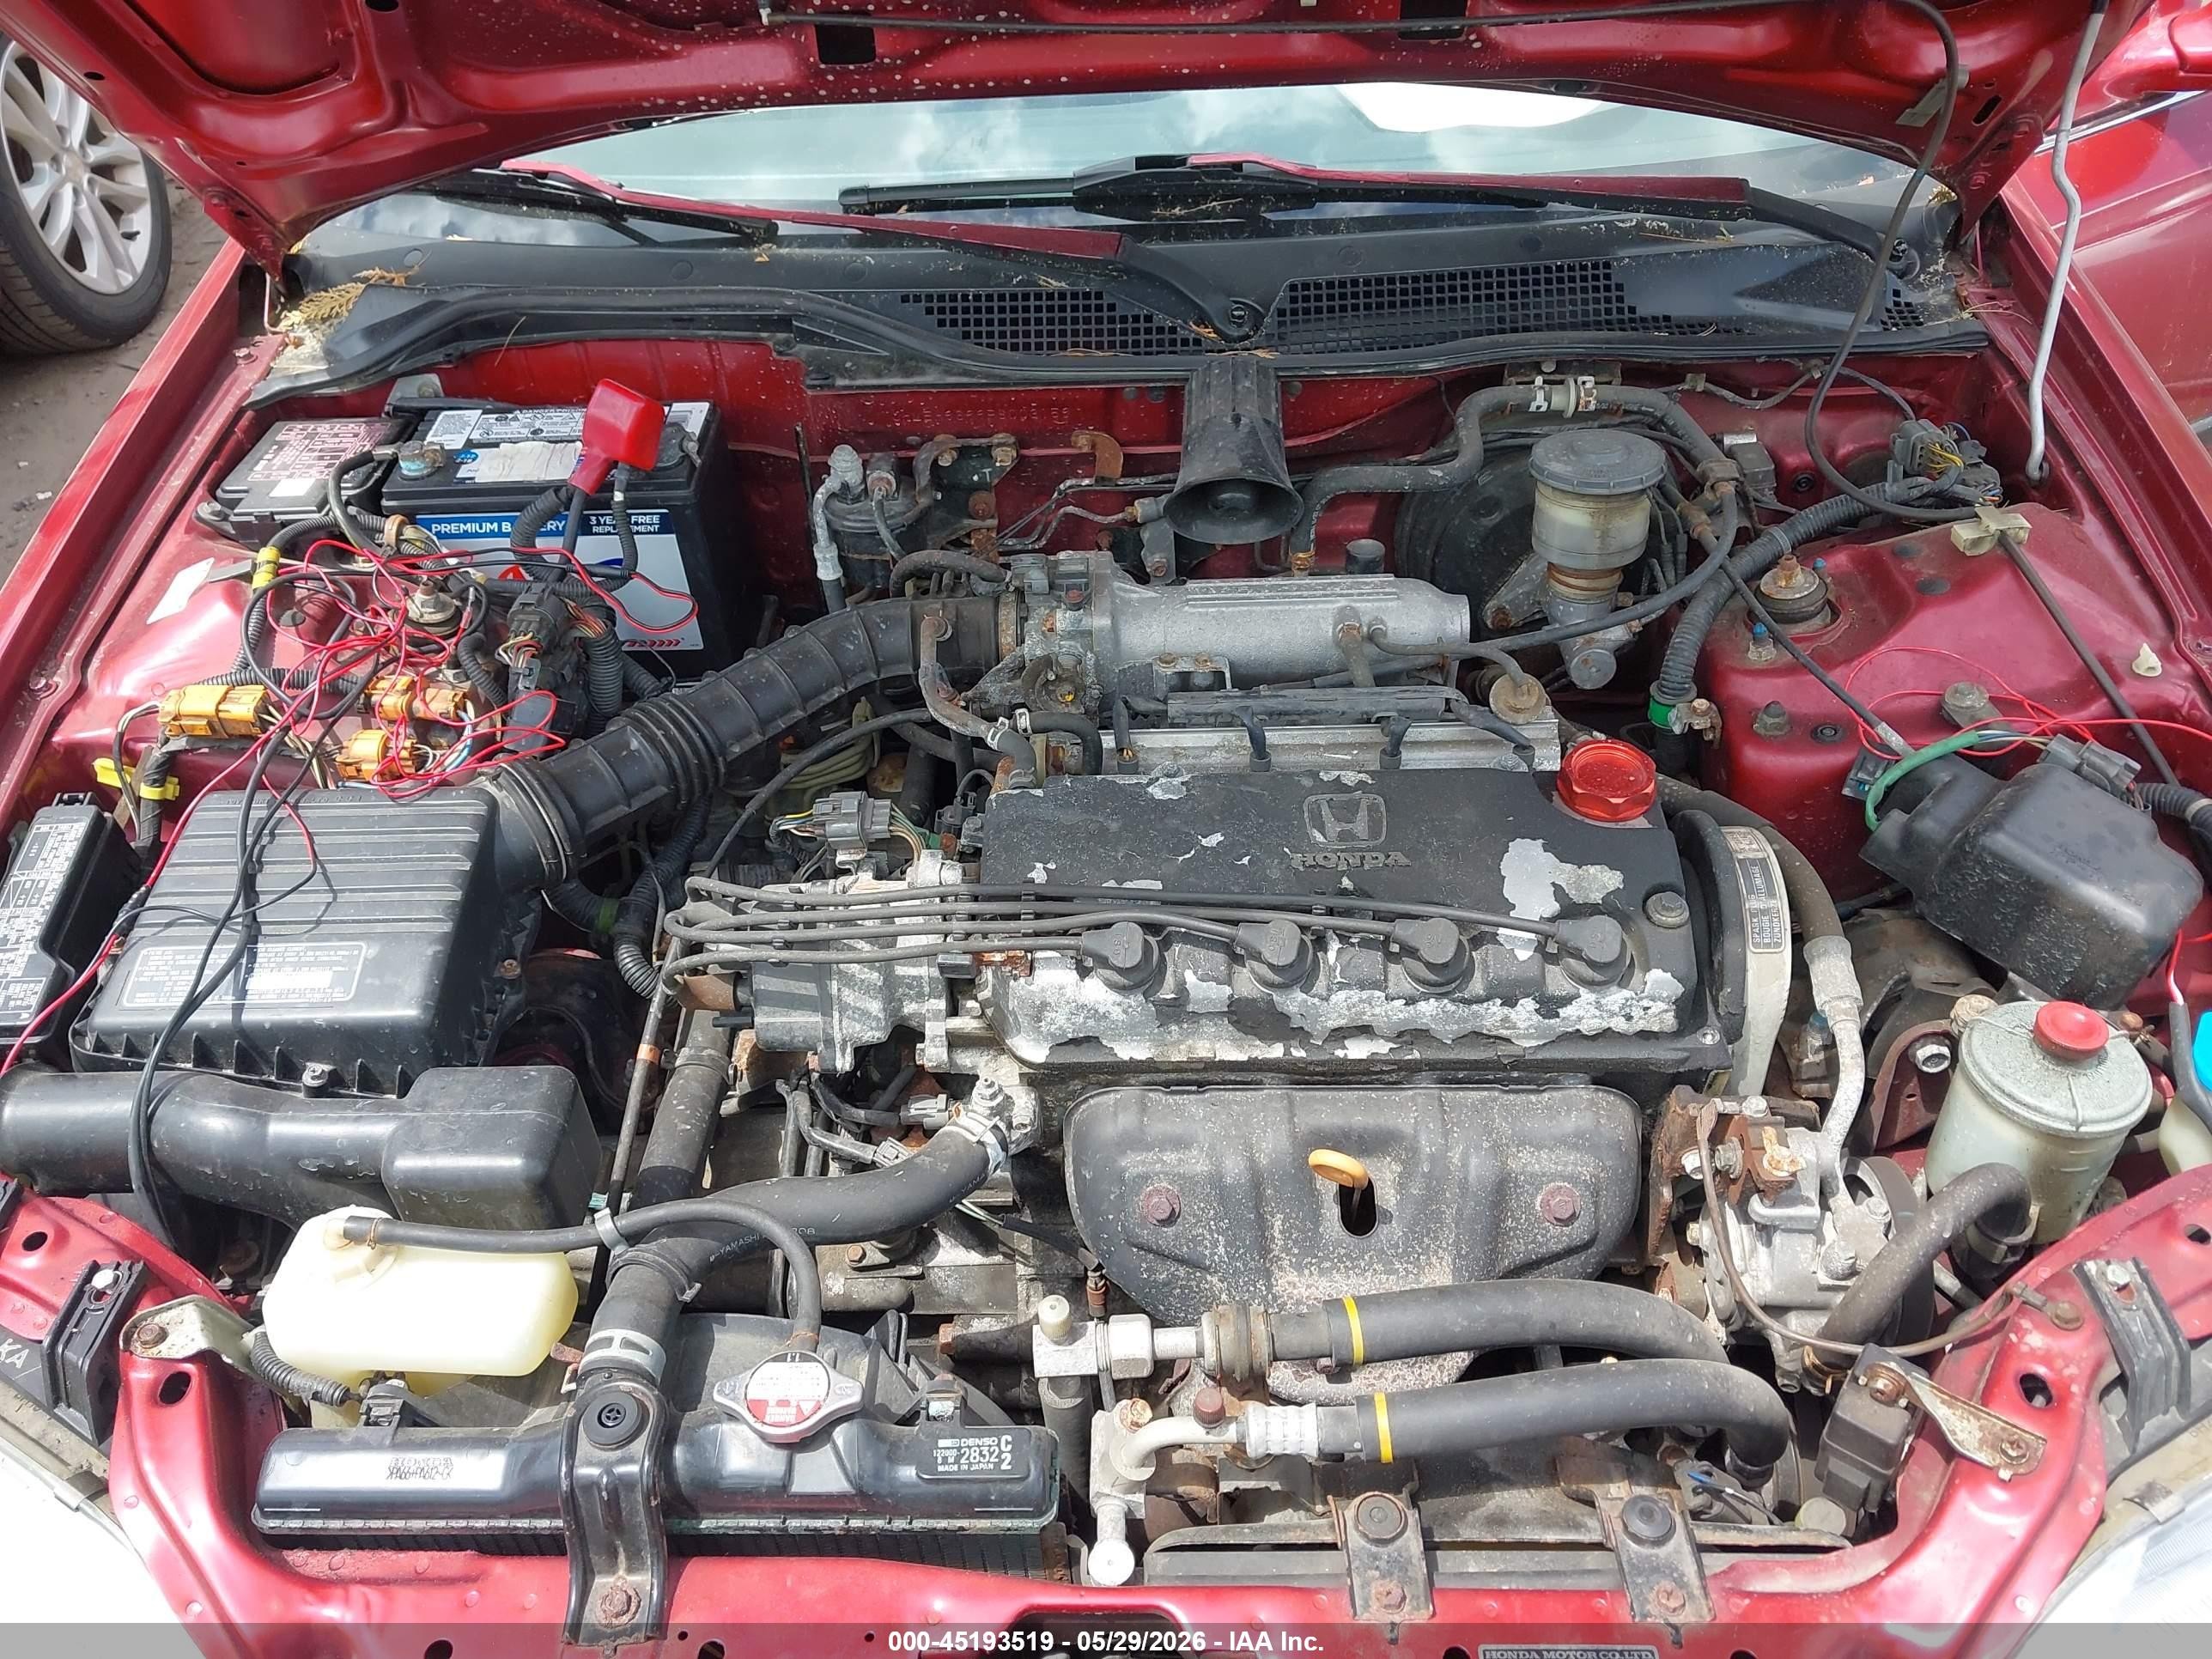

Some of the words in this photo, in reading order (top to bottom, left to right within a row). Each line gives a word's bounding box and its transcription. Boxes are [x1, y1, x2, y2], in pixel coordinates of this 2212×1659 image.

[431, 521, 499, 535] PREMIUM
[589, 515, 597, 525] 3
[630, 514, 660, 524] FREE
[592, 525, 660, 533] REPLMENT
[1291, 851, 1412, 871] HONDA
[1752, 918, 1760, 943] SPARK
[1761, 915, 1771, 943] BOUGIE
[960, 1437, 999, 1447] DENSO
[1000, 1434, 1012, 1452] C
[1000, 1452, 1012, 1470] 2
[1484, 1650, 1539, 1659] HONDA
[1542, 1650, 1597, 1659] MOTOR
